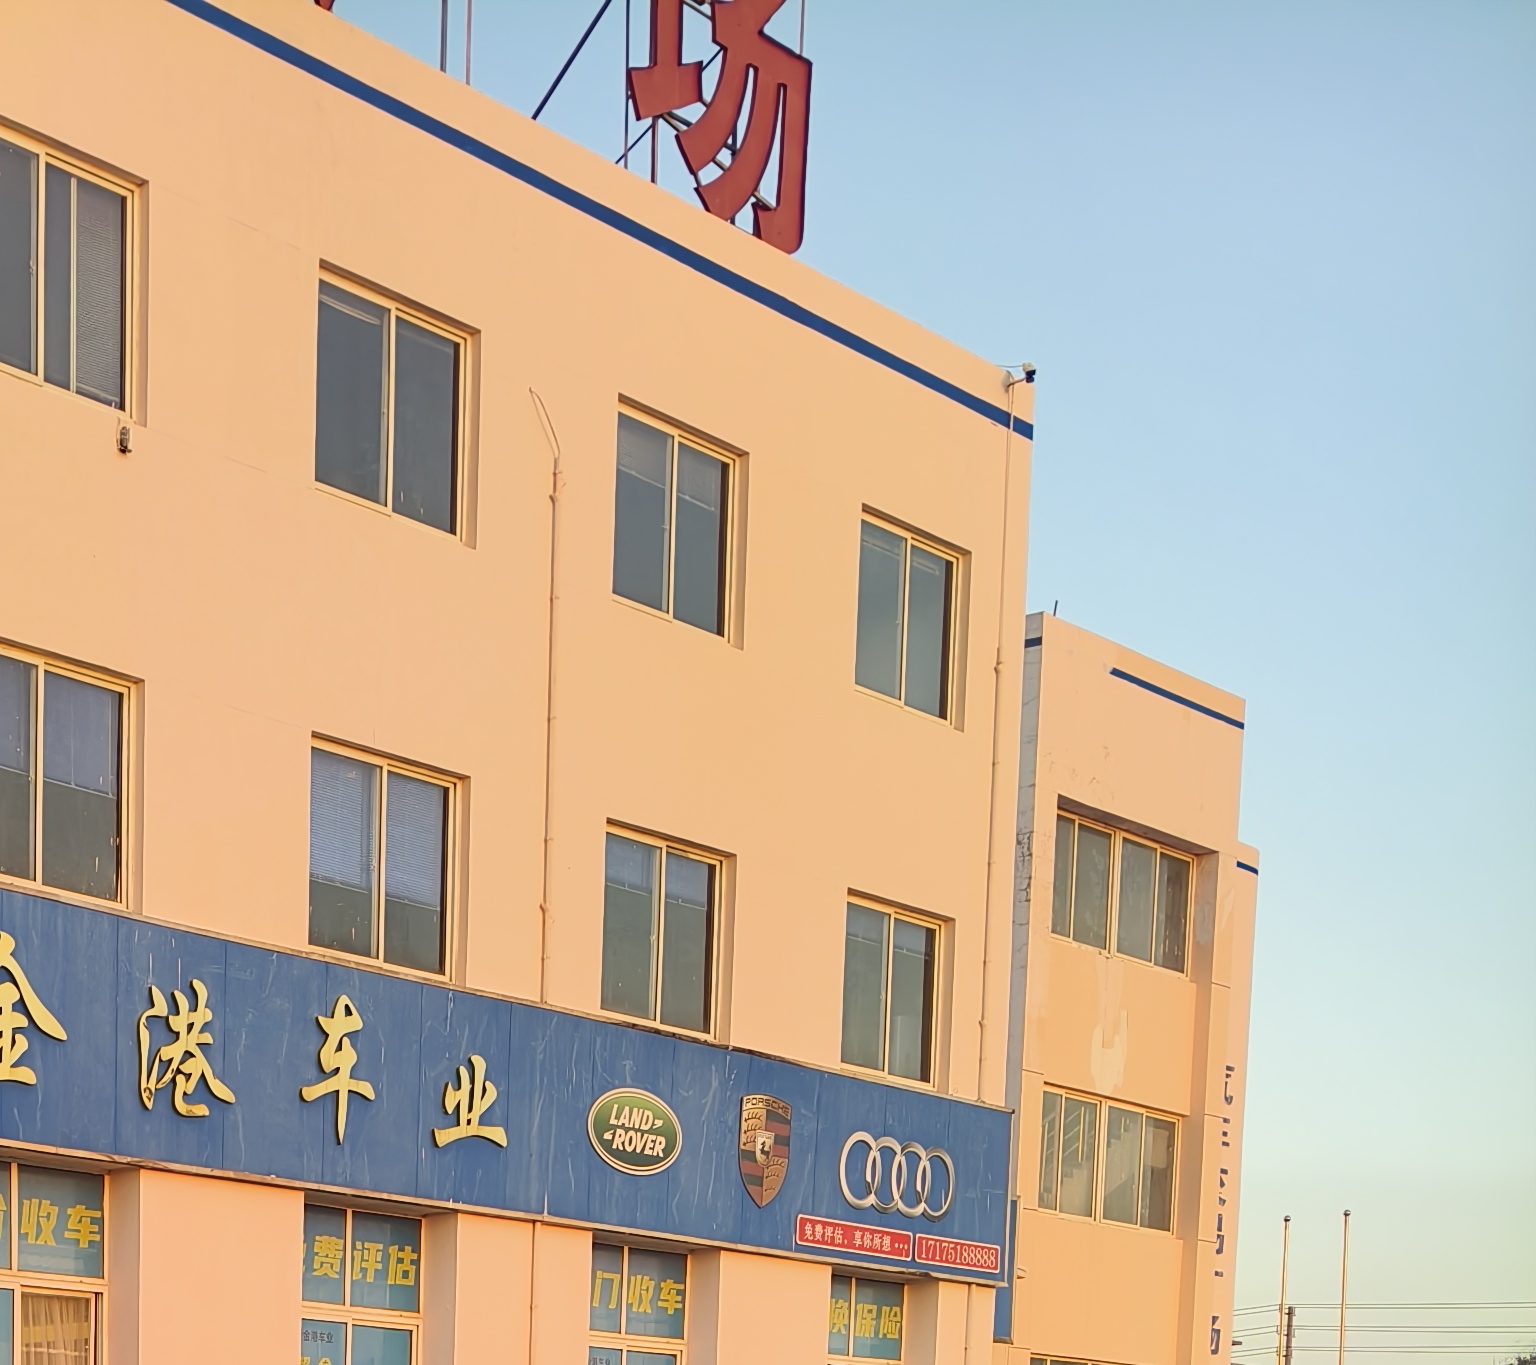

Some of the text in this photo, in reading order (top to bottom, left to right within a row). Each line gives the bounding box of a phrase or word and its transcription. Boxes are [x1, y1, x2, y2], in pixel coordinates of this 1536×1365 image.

[609, 1103, 655, 1131] LAND
[745, 1097, 790, 1117] PORSCHE
[612, 1131, 666, 1158] ROVER
[303, 1234, 418, 1286] 费评估
[921, 1240, 996, 1268] 17175188888
